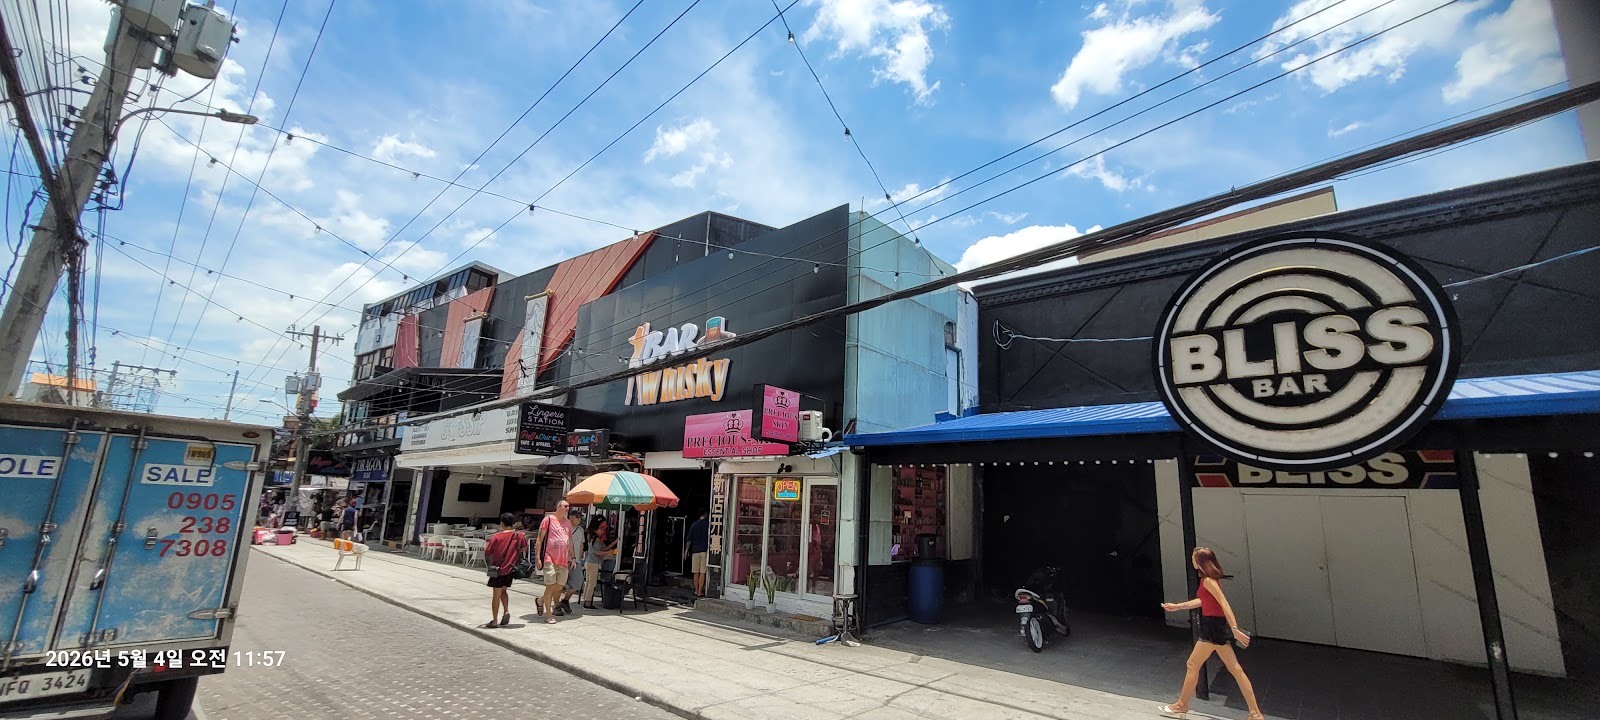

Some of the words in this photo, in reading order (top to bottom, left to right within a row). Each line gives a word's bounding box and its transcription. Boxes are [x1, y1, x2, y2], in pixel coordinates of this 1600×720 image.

[643, 323, 699, 365] BAR
[1170, 305, 1434, 386] BLISS
[1252, 373, 1332, 399] BAR
[527, 404, 565, 419] Lingerie
[764, 407, 798, 420] PRECIOUS
[527, 415, 564, 426] STATION
[772, 420, 789, 430] SKIN
[742, 446, 763, 454] SHOP
[356, 457, 384, 472] DRAGON
[146, 466, 210, 483] SALE
[777, 480, 798, 491] OPEN
[167, 491, 236, 510] 0905
[710, 472, 726, 554] 新店开幕
[179, 516, 231, 534] 238
[159, 539, 227, 557] 7308
[41, 674, 86, 691] 3424
